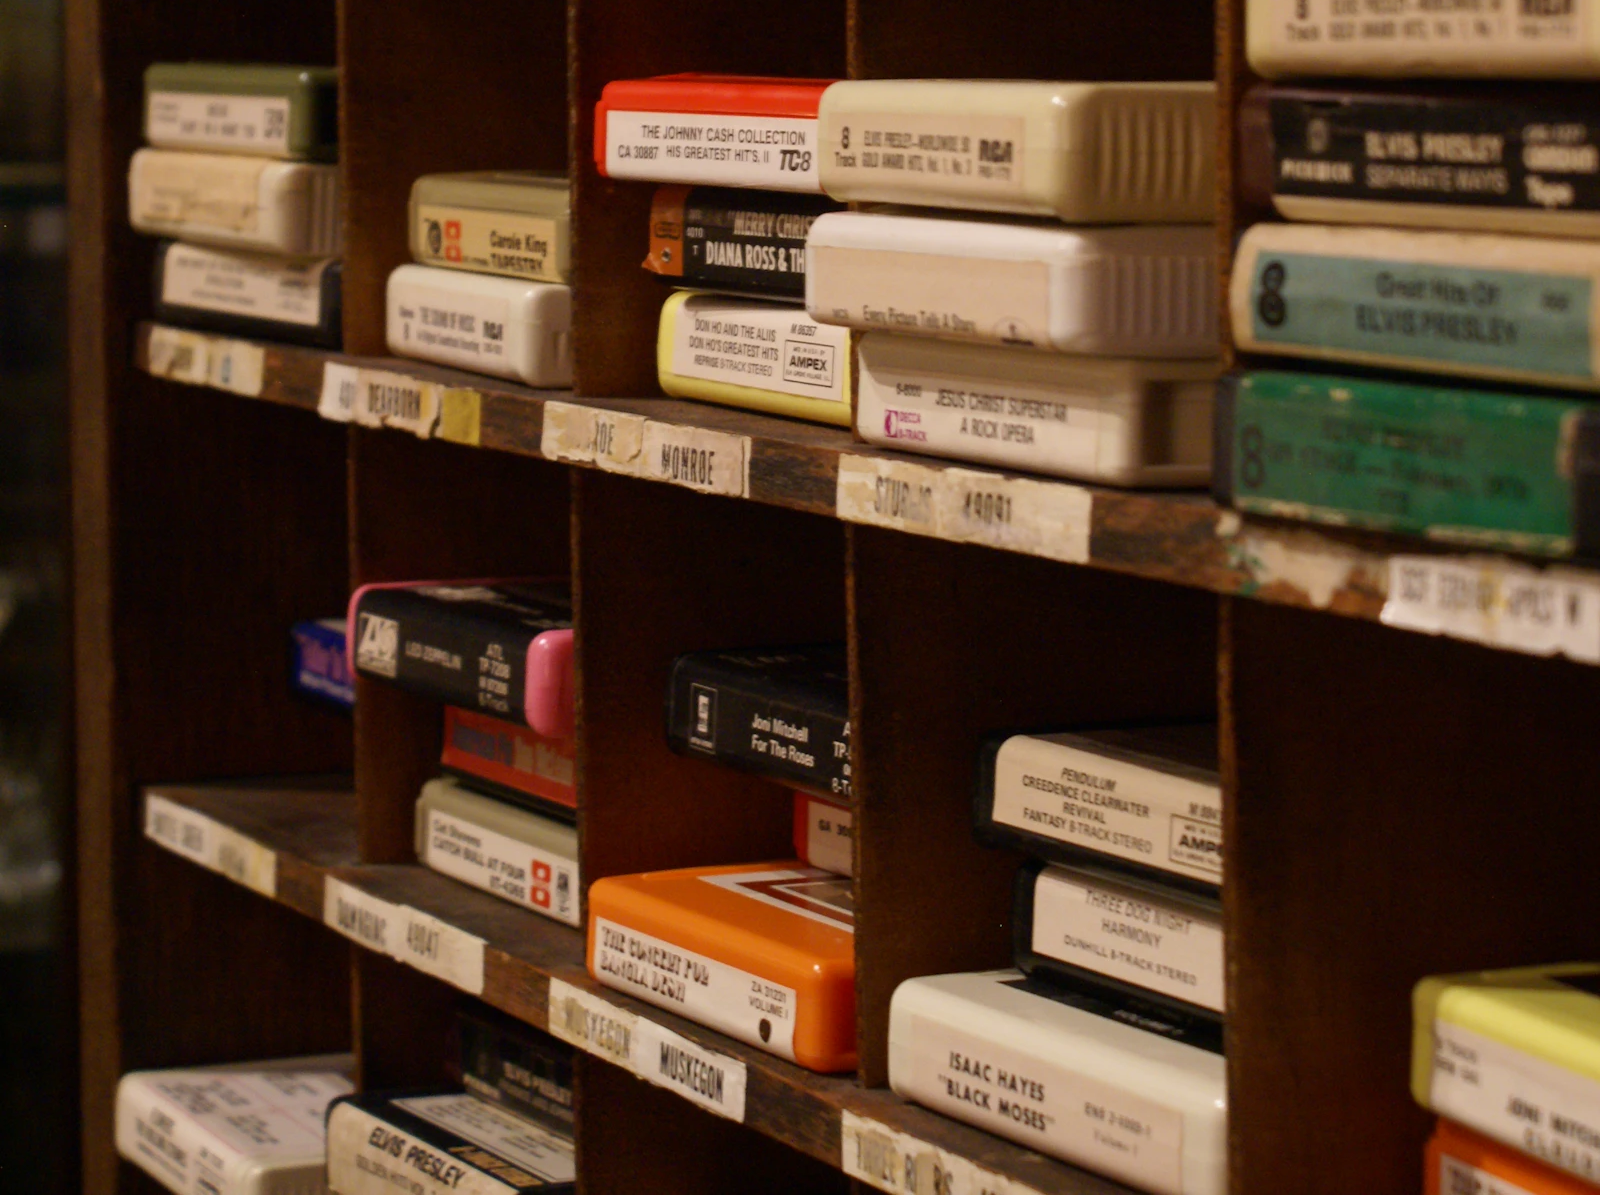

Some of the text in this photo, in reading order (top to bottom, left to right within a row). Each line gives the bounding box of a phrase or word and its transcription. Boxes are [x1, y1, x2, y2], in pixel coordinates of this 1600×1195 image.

[642, 125, 805, 146] THE JOHNNY CASH COLLECTION
[841, 125, 850, 150] 8
[618, 144, 631, 159] CA
[666, 145, 681, 158] HIS
[684, 146, 731, 161] GREATEST
[779, 149, 812, 172] TC8
[835, 151, 856, 168] Track
[979, 138, 1013, 163] RCA
[489, 230, 547, 258] Carole King
[705, 241, 806, 274] DIANA ROSS & TH
[490, 253, 543, 272] TAPESTRY
[482, 320, 503, 342] RCA
[695, 318, 709, 332] DON
[711, 321, 721, 334] HO
[724, 323, 739, 337] AND
[741, 325, 754, 339] THE
[862, 305, 887, 324] Every
[888, 307, 918, 326] Picture
[951, 314, 978, 334] Story
[689, 335, 779, 361] DON HO'S GREATEST HITS
[694, 355, 719, 368] REPRISE
[747, 362, 773, 377] STEREO
[789, 355, 827, 371] AMPEX
[900, 411, 921, 424] DECCA
[935, 389, 1069, 423] JESUS CHRIST SUPERSTAR
[960, 417, 1034, 444] A ROCK OPERA
[661, 443, 715, 485] MONROE
[752, 713, 809, 743] Joni Mitchell
[752, 734, 815, 767] For The Roses
[1061, 767, 1117, 793] PENDULUM
[1022, 774, 1150, 818] CREEDENCE CLEARWATER
[1062, 801, 1107, 824] REVIVAL
[433, 818, 481, 848] Cat Stevens
[1022, 807, 1067, 835] FANTASY
[1112, 832, 1153, 854] STEREO
[433, 836, 526, 882] CATCH BULL AT FOUR
[1085, 889, 1192, 935] THREE DOG NIGHT
[1101, 918, 1163, 950] HARMONY
[602, 926, 711, 988] THE CONCERT FOR
[1064, 934, 1108, 958] DUNHILL
[1156, 963, 1198, 987] STEREO
[600, 951, 686, 1004] BANGLA DESH
[749, 995, 784, 1019] VOLUME
[659, 1041, 725, 1104] MUSKEGON
[949, 1051, 1046, 1103] ISAAC HAYES
[938, 1073, 1056, 1133] "BLACK MOSES"
[368, 1126, 467, 1189] ELVIS PRESLEY
